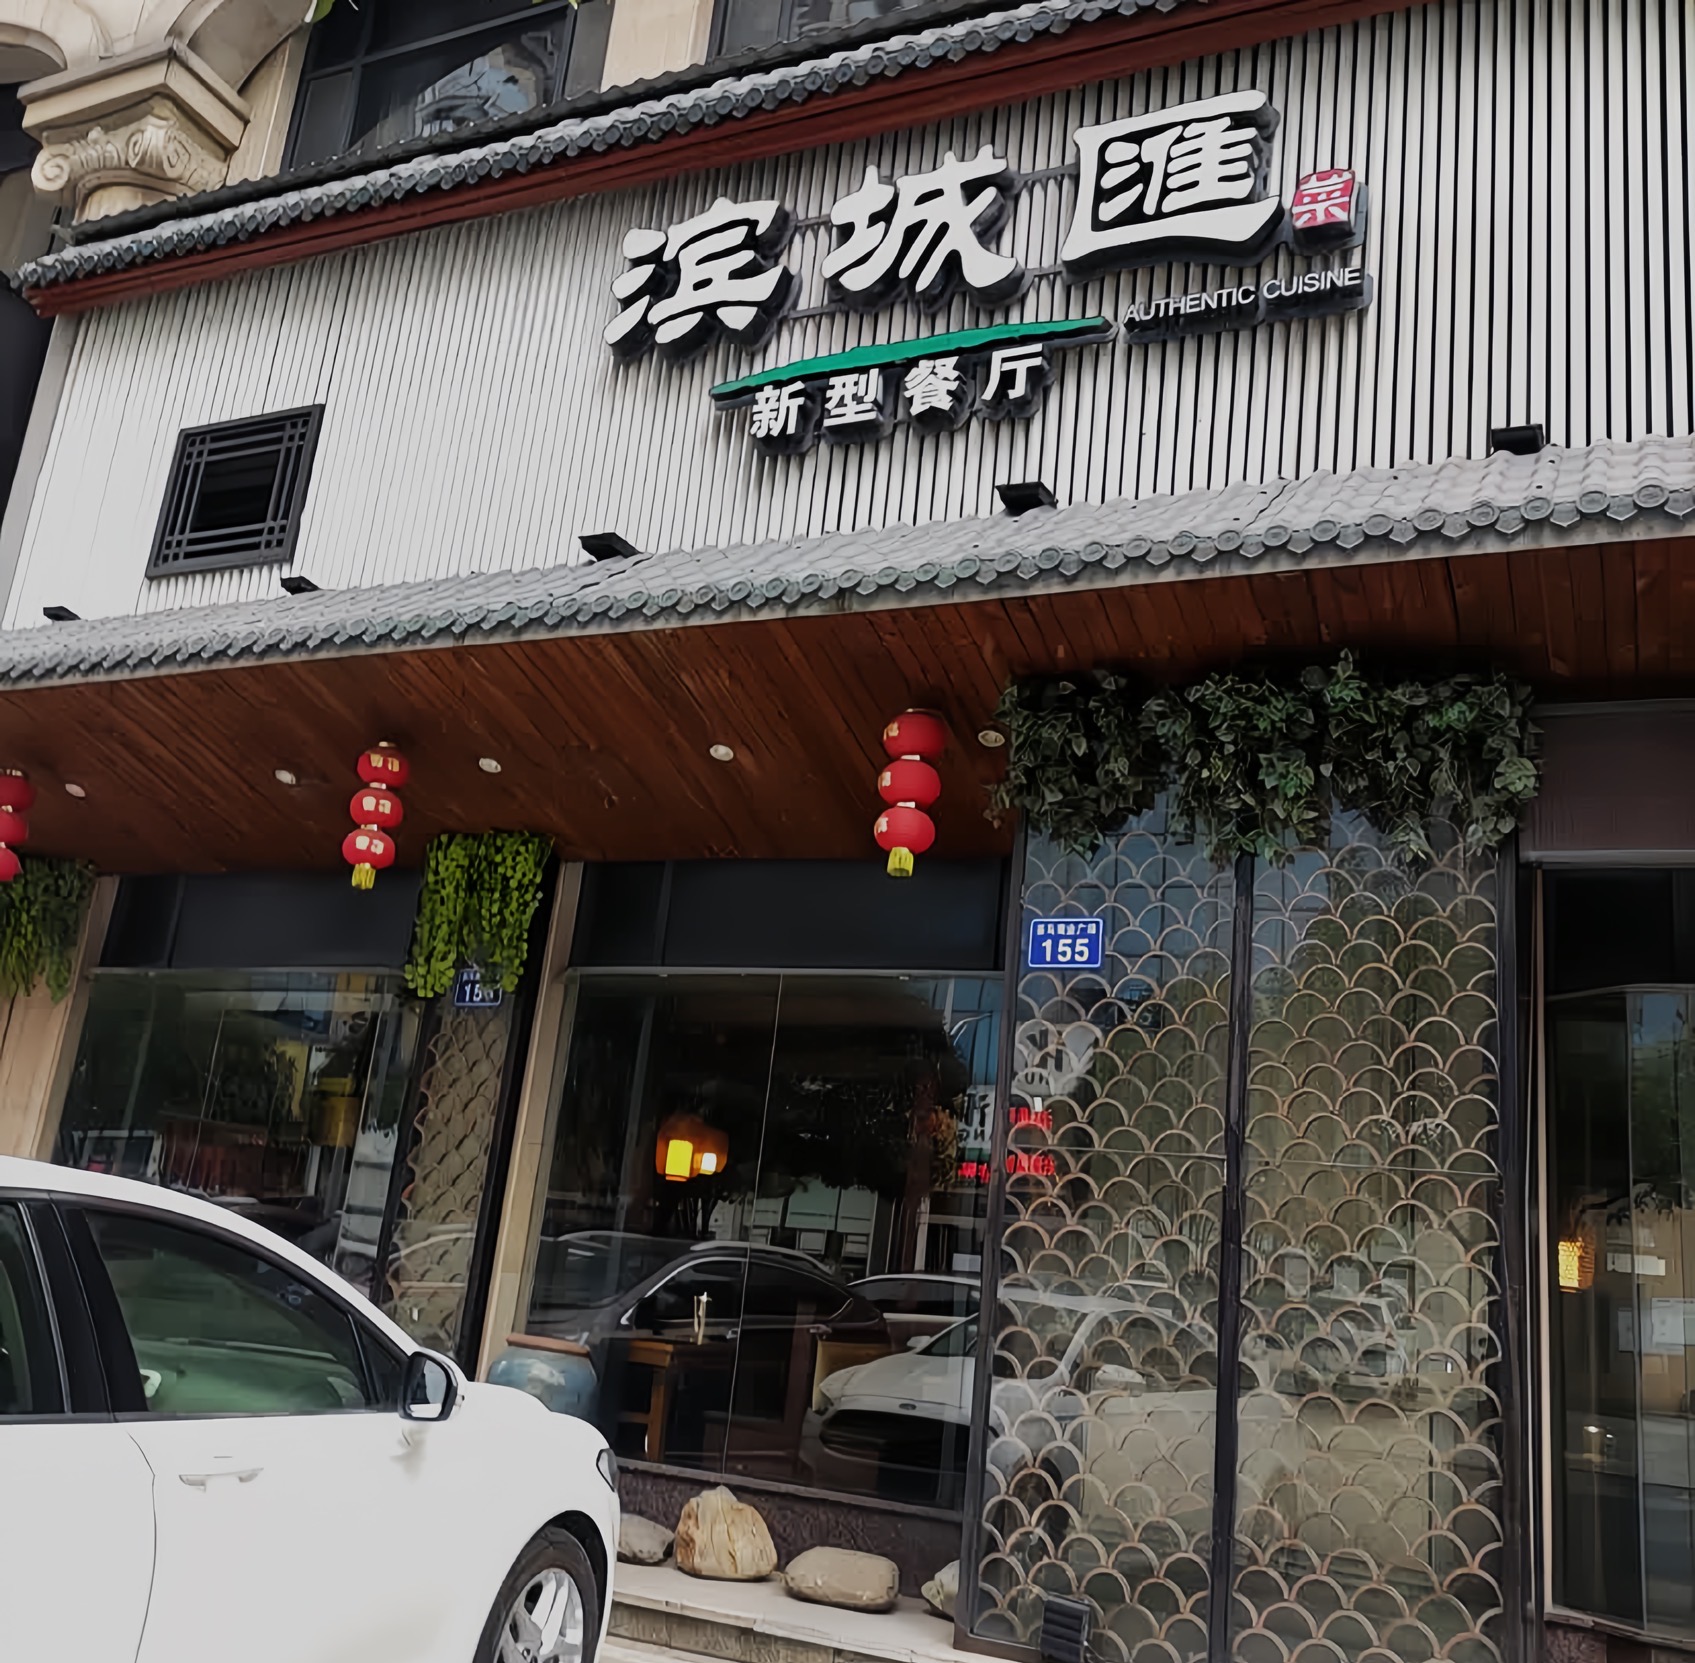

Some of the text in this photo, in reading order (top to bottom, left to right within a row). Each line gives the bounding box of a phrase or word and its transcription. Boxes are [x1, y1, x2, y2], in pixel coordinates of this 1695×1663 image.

[1124, 267, 1362, 324] AUTHENTIC CUISINE
[750, 343, 1043, 438] 新型餐厅
[1042, 938, 1089, 962] 155
